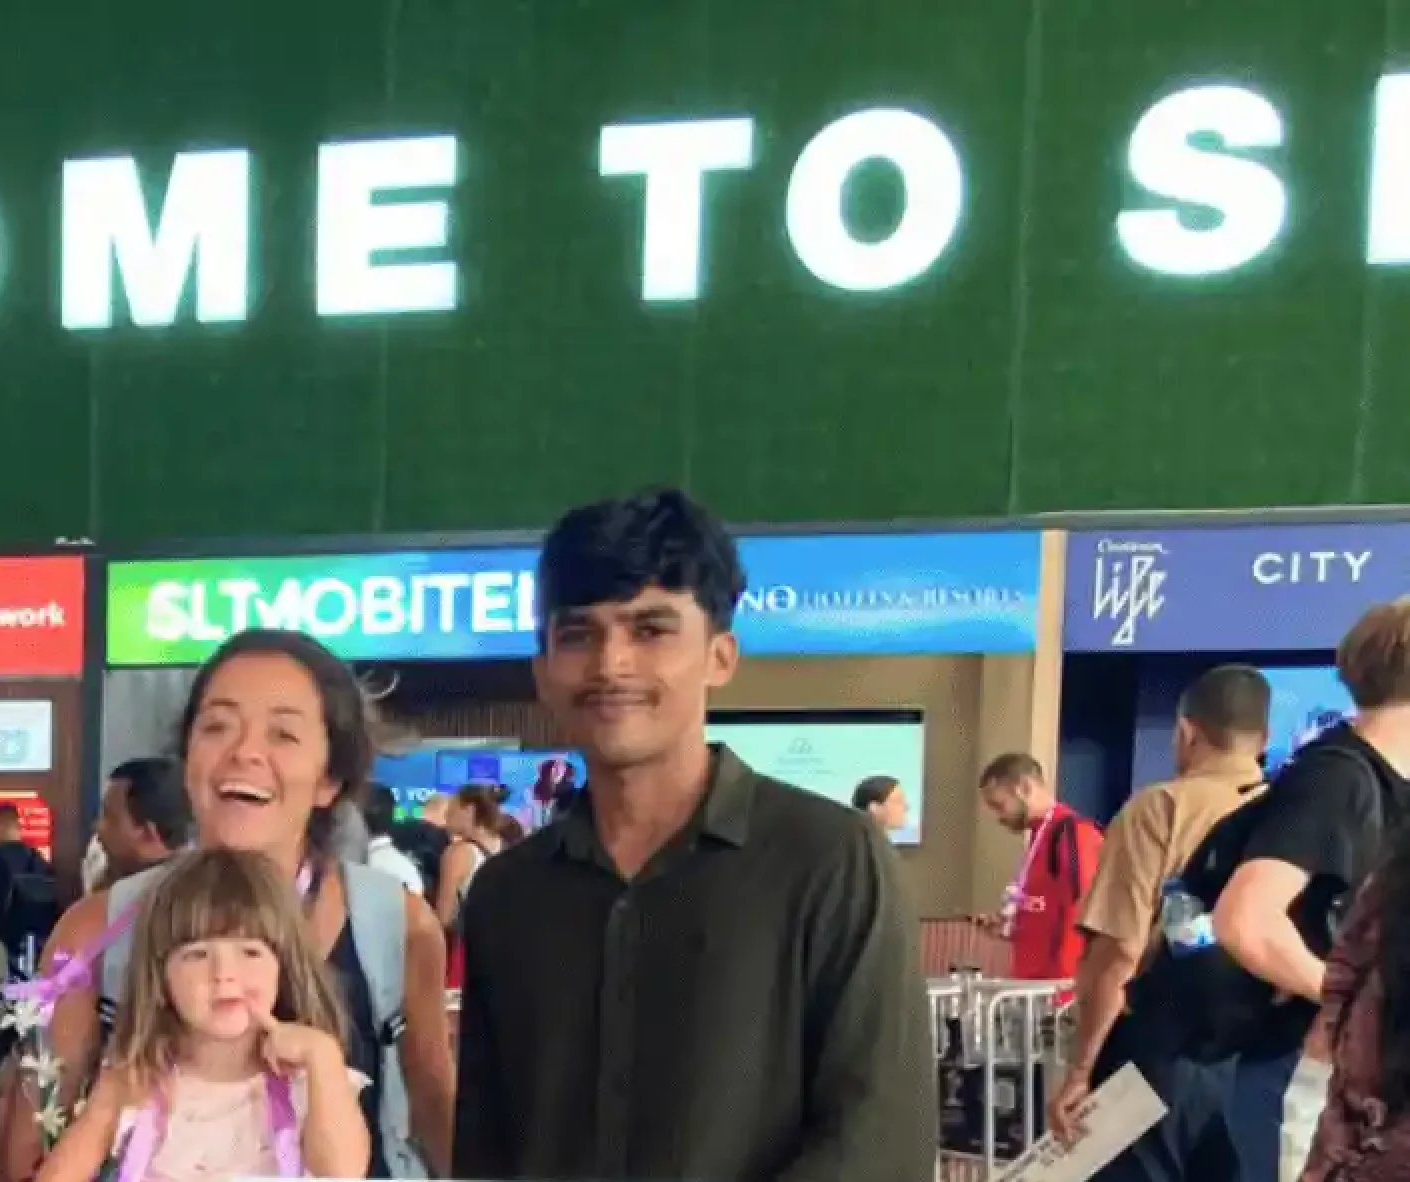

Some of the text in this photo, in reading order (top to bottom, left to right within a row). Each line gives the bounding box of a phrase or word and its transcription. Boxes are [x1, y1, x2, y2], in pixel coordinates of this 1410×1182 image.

[600, 108, 963, 300] TO
[1116, 72, 1410, 278] S
[1251, 551, 1373, 586] CITY
